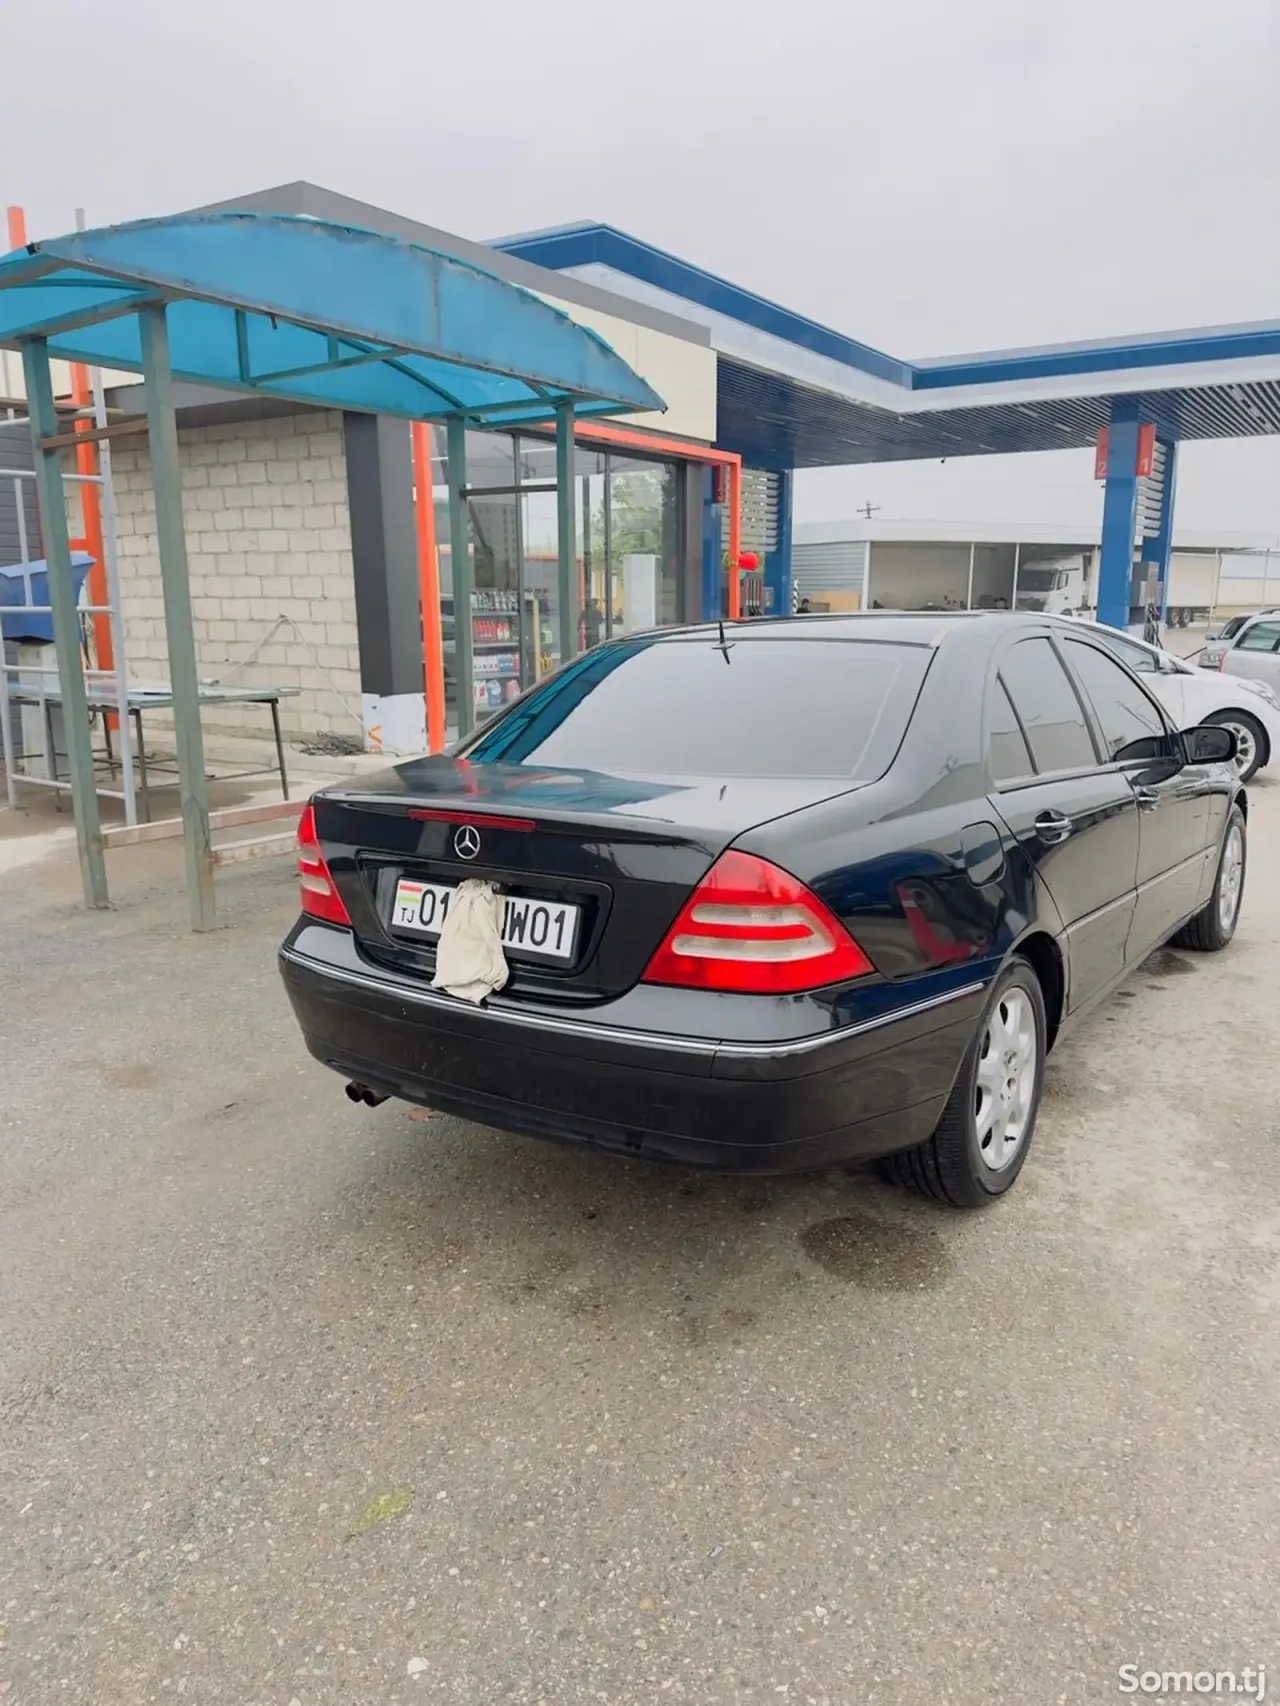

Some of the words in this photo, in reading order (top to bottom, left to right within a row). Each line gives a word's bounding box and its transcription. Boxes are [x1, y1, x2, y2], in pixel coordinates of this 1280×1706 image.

[1097, 461, 1107, 476] 2
[1140, 457, 1149, 473] 1
[400, 907, 415, 923] TJ
